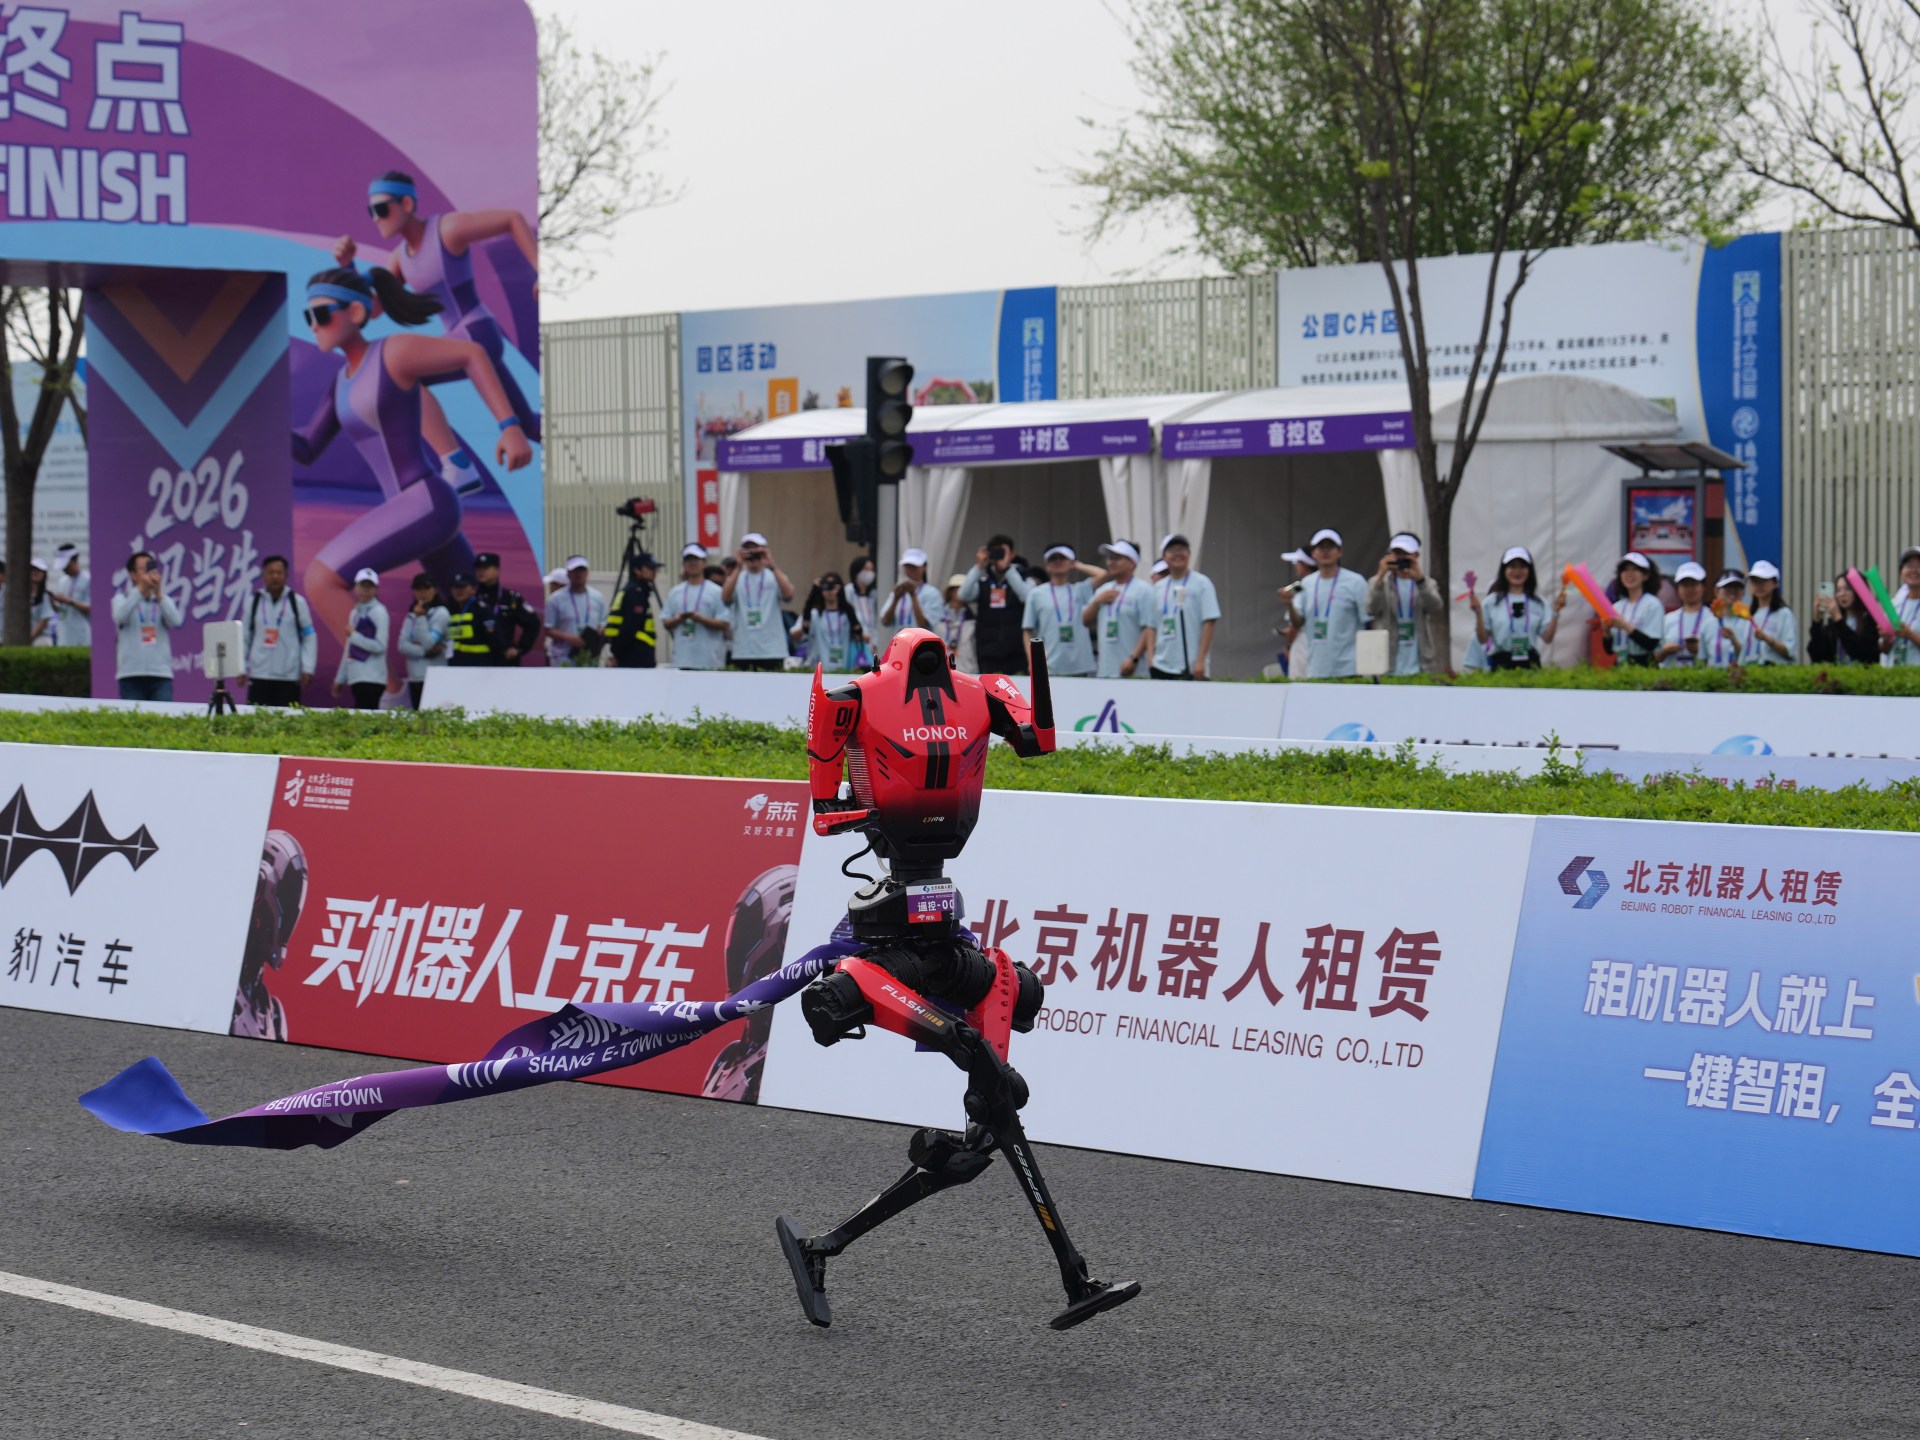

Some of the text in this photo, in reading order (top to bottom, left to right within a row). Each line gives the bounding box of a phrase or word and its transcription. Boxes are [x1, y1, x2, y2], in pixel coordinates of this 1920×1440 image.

[0, 6, 190, 136] 终点
[0, 144, 188, 224] INISH
[1302, 310, 1400, 338] 公园C片区
[697, 342, 776, 373] 园区活动
[1019, 427, 1070, 453] 计时区
[1268, 420, 1325, 447] 音控区
[145, 450, 248, 538] 2026
[808, 693, 817, 741] HONOR
[903, 727, 968, 742] HONOR
[765, 801, 799, 821] 京东
[1623, 860, 1843, 907] 北京机器人租赁
[1621, 901, 1836, 925] BEIJING ROBOT FINANCIAL LEASING CO.,LTD
[7, 927, 133, 994] 豹汽车
[303, 895, 710, 1011] 买机器人上京东
[970, 898, 1442, 1022] 北京机器人租赁
[881, 984, 926, 1014] FLASH
[1583, 959, 1875, 1040] 租机器人就上
[528, 1052, 594, 1073] SHANG
[602, 1032, 663, 1063] E-TOWN
[1037, 1007, 1424, 1069] ROBOT FINANCIAL LEASING CO.,LTD
[1014, 1144, 1044, 1204] SPEED
